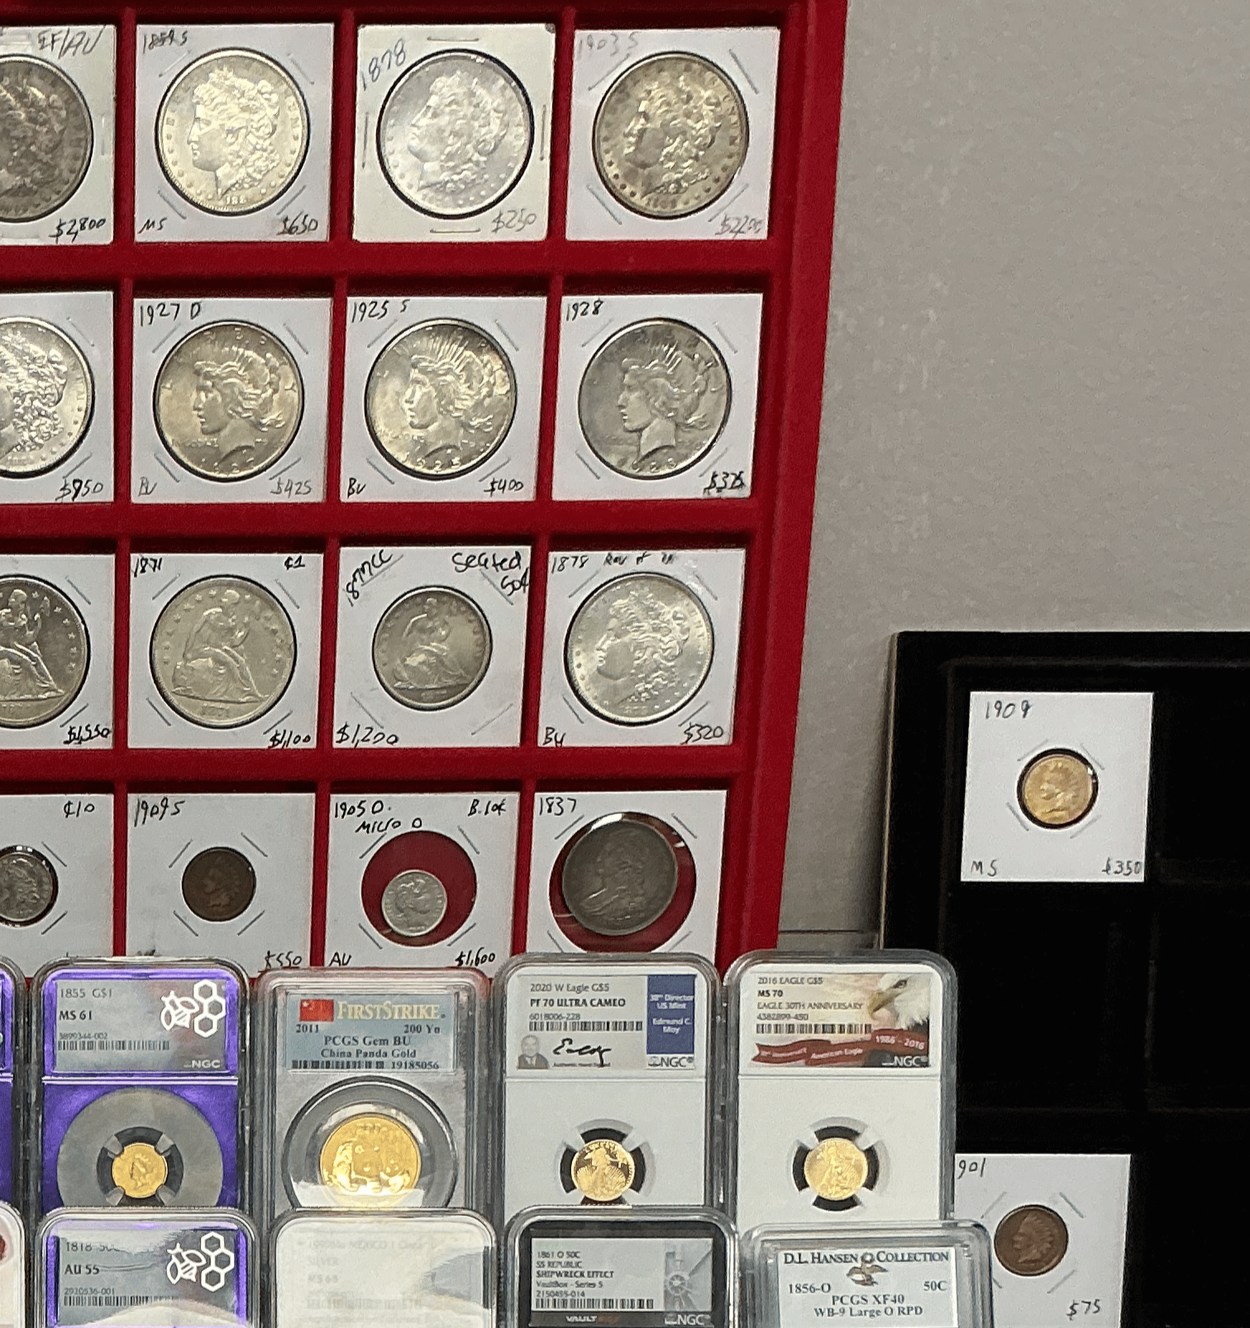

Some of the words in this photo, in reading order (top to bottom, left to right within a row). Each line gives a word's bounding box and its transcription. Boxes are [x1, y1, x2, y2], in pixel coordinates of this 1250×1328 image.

[50, 217, 106, 243] $2,800
[144, 218, 166, 233] MS
[492, 211, 537, 232] $250
[138, 301, 181, 326] 1927
[351, 299, 390, 322] 1925
[565, 299, 606, 321] 1928
[270, 476, 313, 496] $425
[484, 476, 524, 497] $400
[132, 556, 162, 578] 1871
[451, 552, 523, 573] Seated
[985, 699, 1034, 719] 1909
[336, 722, 398, 748] $1,200
[681, 719, 724, 743] $320
[538, 796, 578, 817] 1837
[330, 953, 353, 966] AU
[190, 1058, 221, 1069] NGC
[320, 1048, 353, 1059] China
[355, 1048, 388, 1059] Panda
[390, 1048, 417, 1059] Gold
[788, 1282, 832, 1294] 1856-O
[923, 1280, 948, 1292] 50C
[832, 1294, 870, 1306] PCGS
[872, 1294, 906, 1306] XF40
[1066, 1300, 1101, 1321] $75
